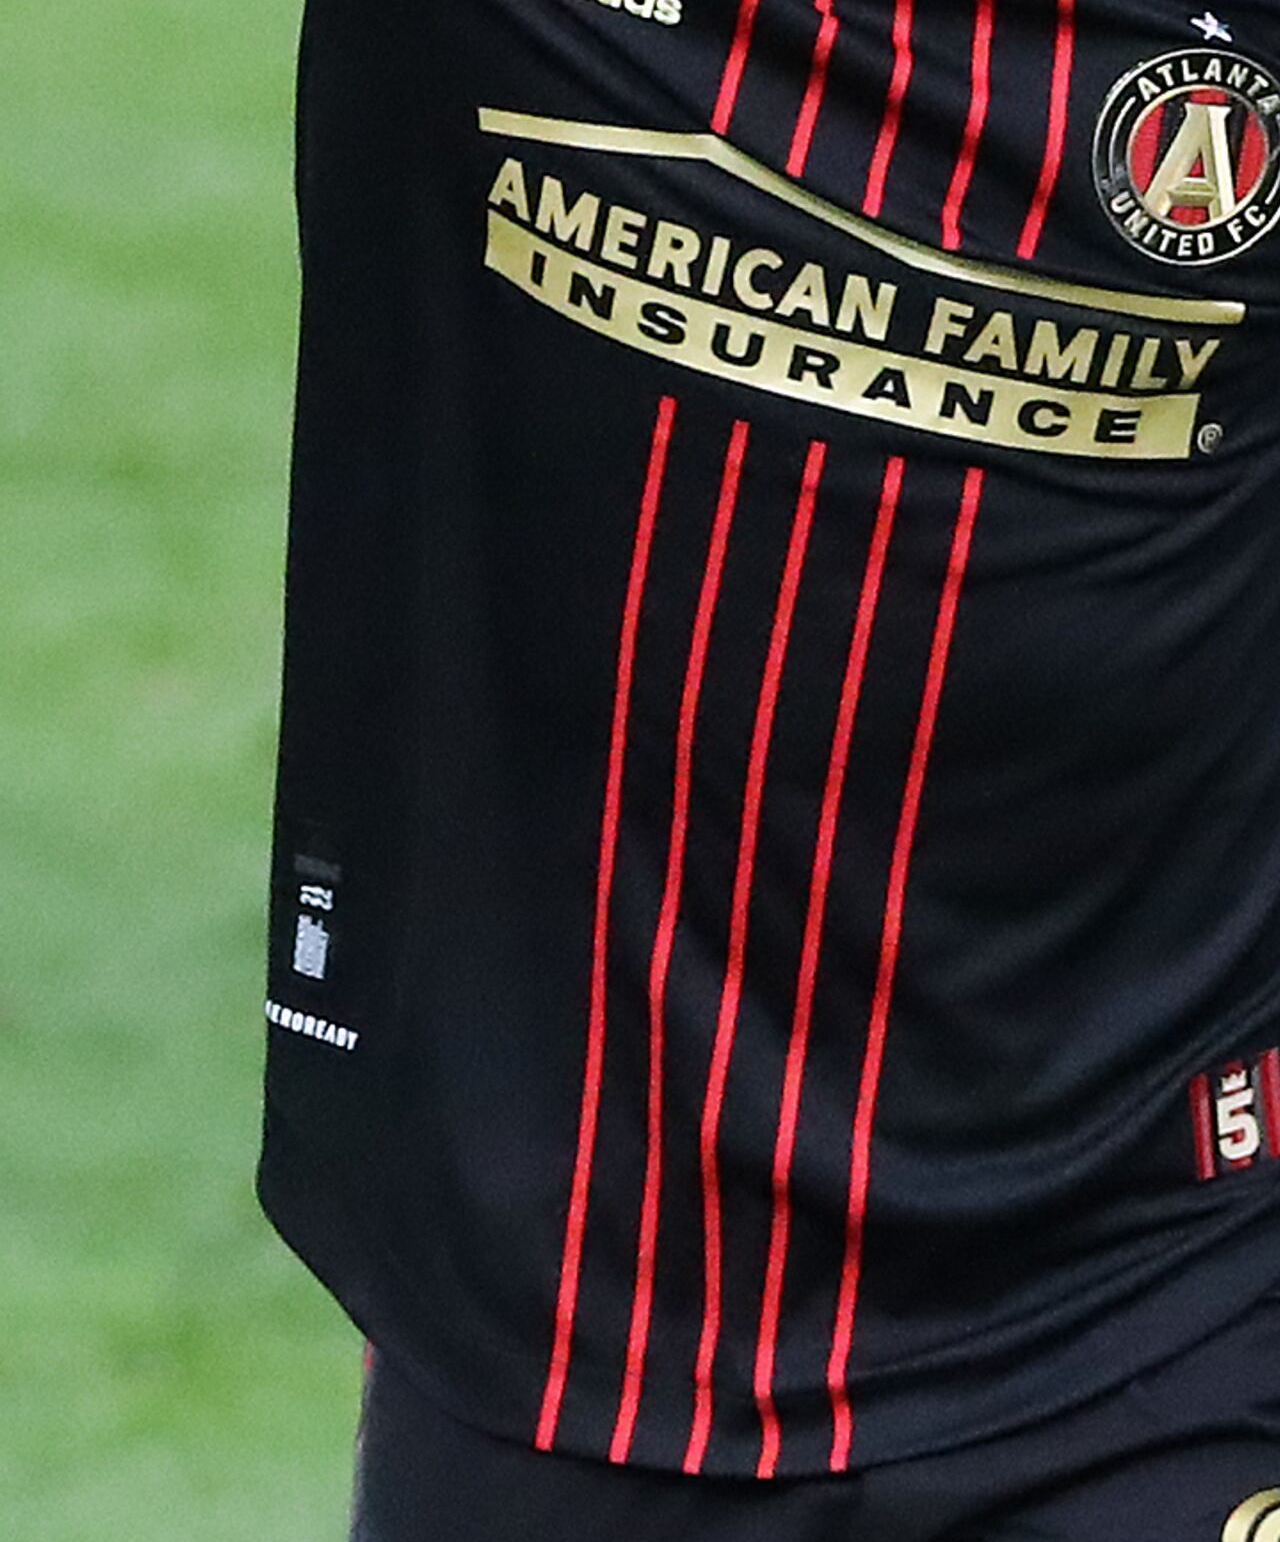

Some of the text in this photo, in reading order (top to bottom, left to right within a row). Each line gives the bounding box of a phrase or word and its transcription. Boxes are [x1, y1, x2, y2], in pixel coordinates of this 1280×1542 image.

[1143, 102, 1237, 223] A
[488, 157, 1220, 391] AMERICAN FAMILY
[1110, 191, 1268, 257] UNITED FC
[530, 251, 1143, 445] INSURANCE
[1216, 1087, 1261, 1161] 5
